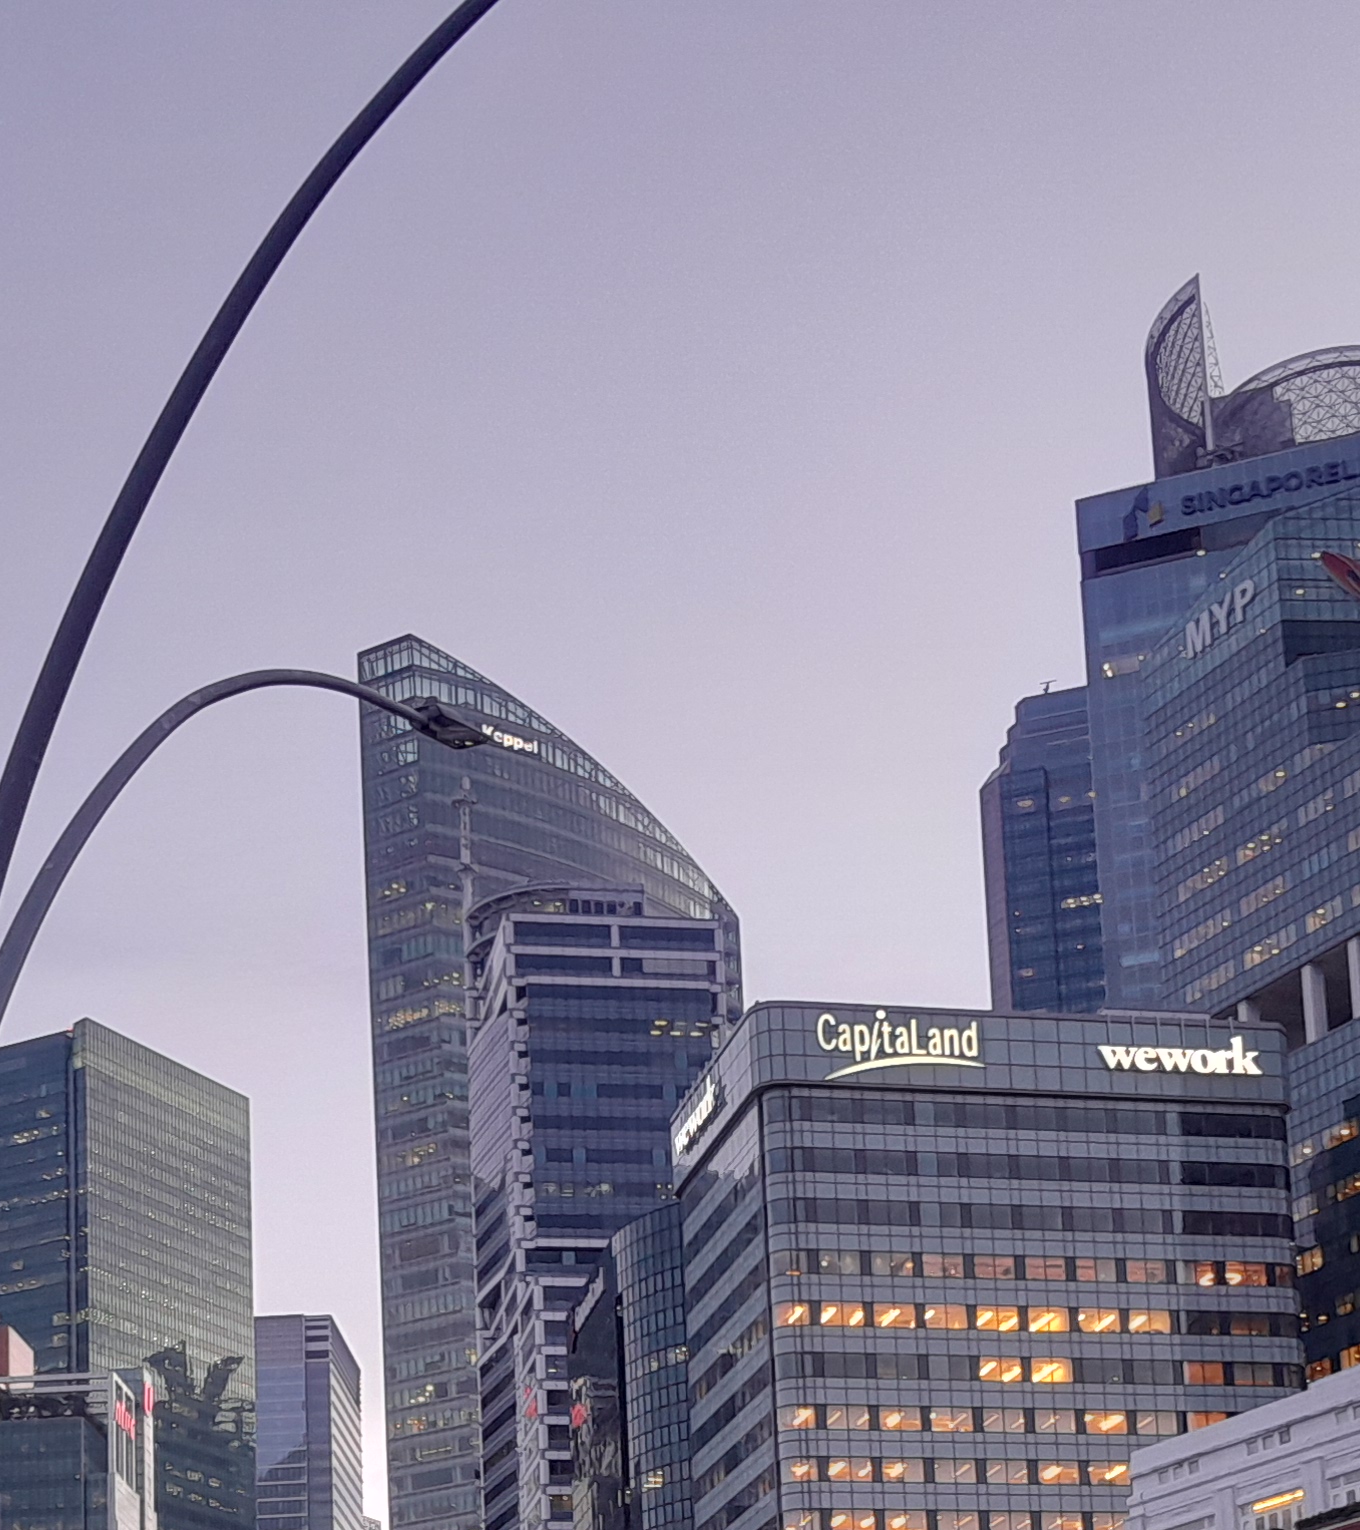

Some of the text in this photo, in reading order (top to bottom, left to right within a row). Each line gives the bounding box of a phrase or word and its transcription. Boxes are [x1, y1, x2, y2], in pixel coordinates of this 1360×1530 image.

[1185, 579, 1255, 659] MYP
[816, 1009, 980, 1061] CapitaLand
[1096, 1036, 1264, 1076] wework
